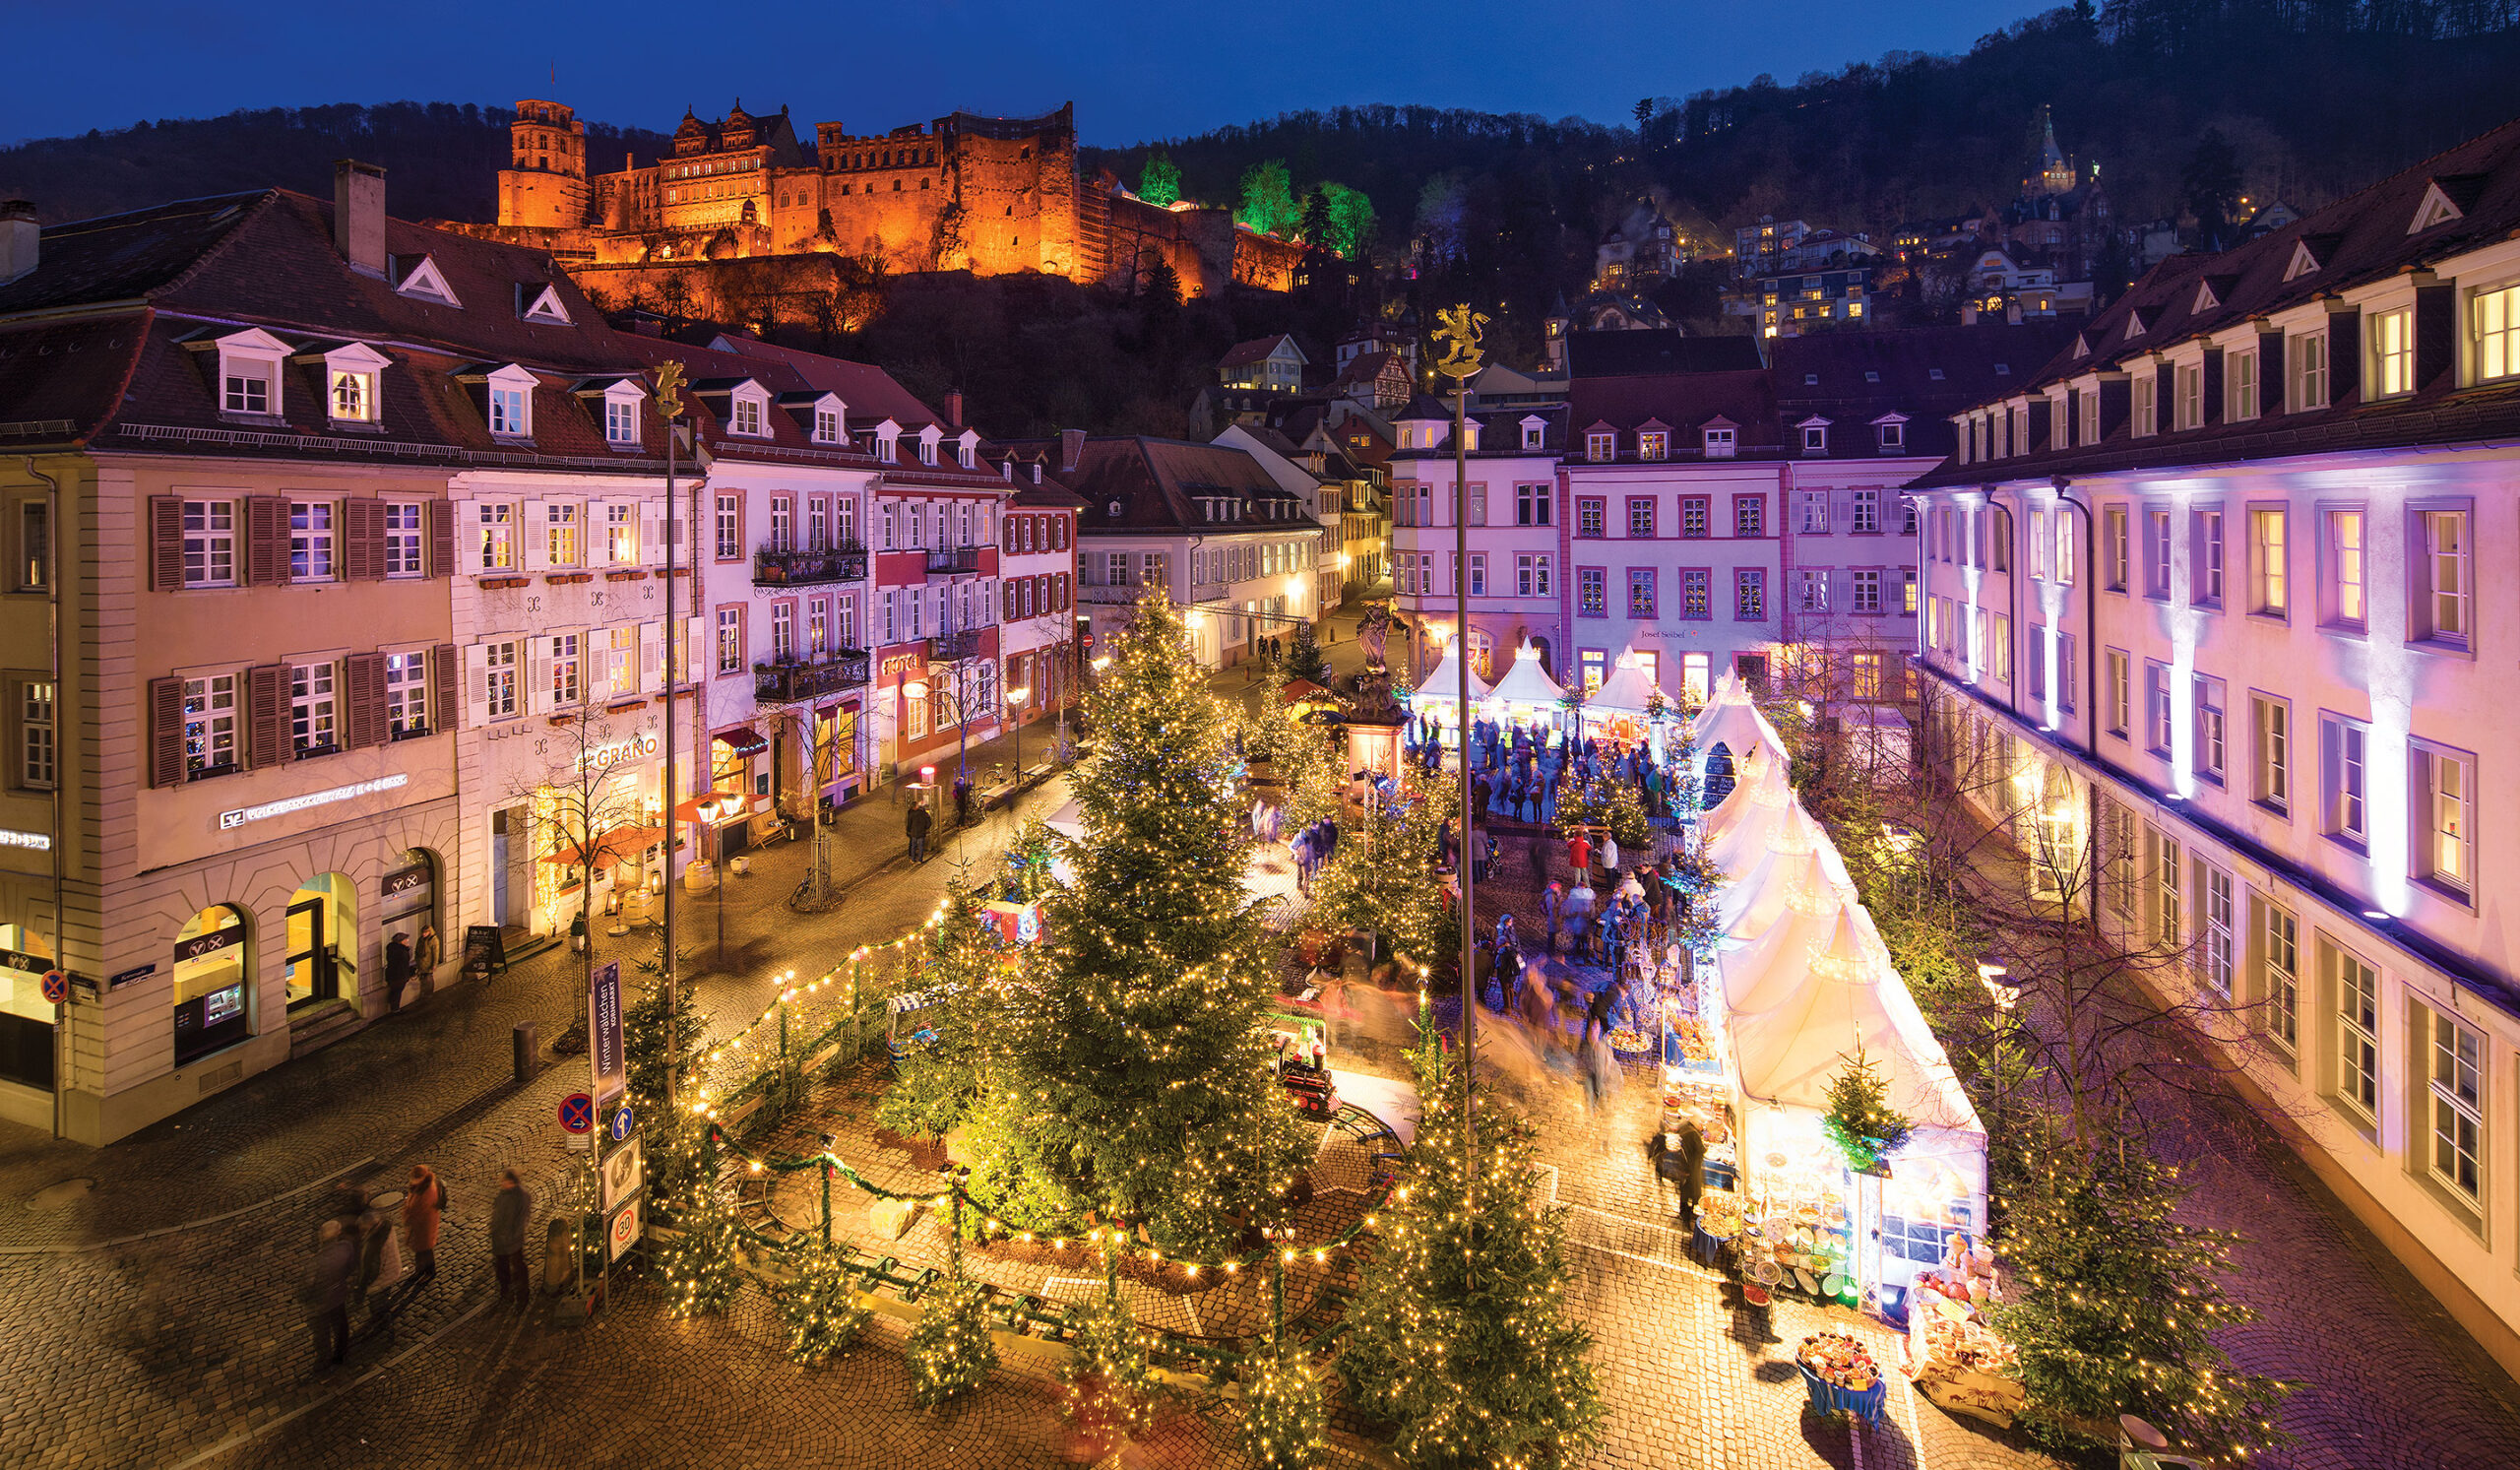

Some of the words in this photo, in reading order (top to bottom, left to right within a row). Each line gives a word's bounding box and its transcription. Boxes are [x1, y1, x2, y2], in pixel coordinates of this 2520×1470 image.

[882, 654, 921, 675] HOTEL
[597, 737, 657, 766] GRANO
[608, 981, 617, 1028] KORNMARKT
[599, 984, 611, 1076] Winterwäldchen
[619, 1216, 630, 1235] 30
